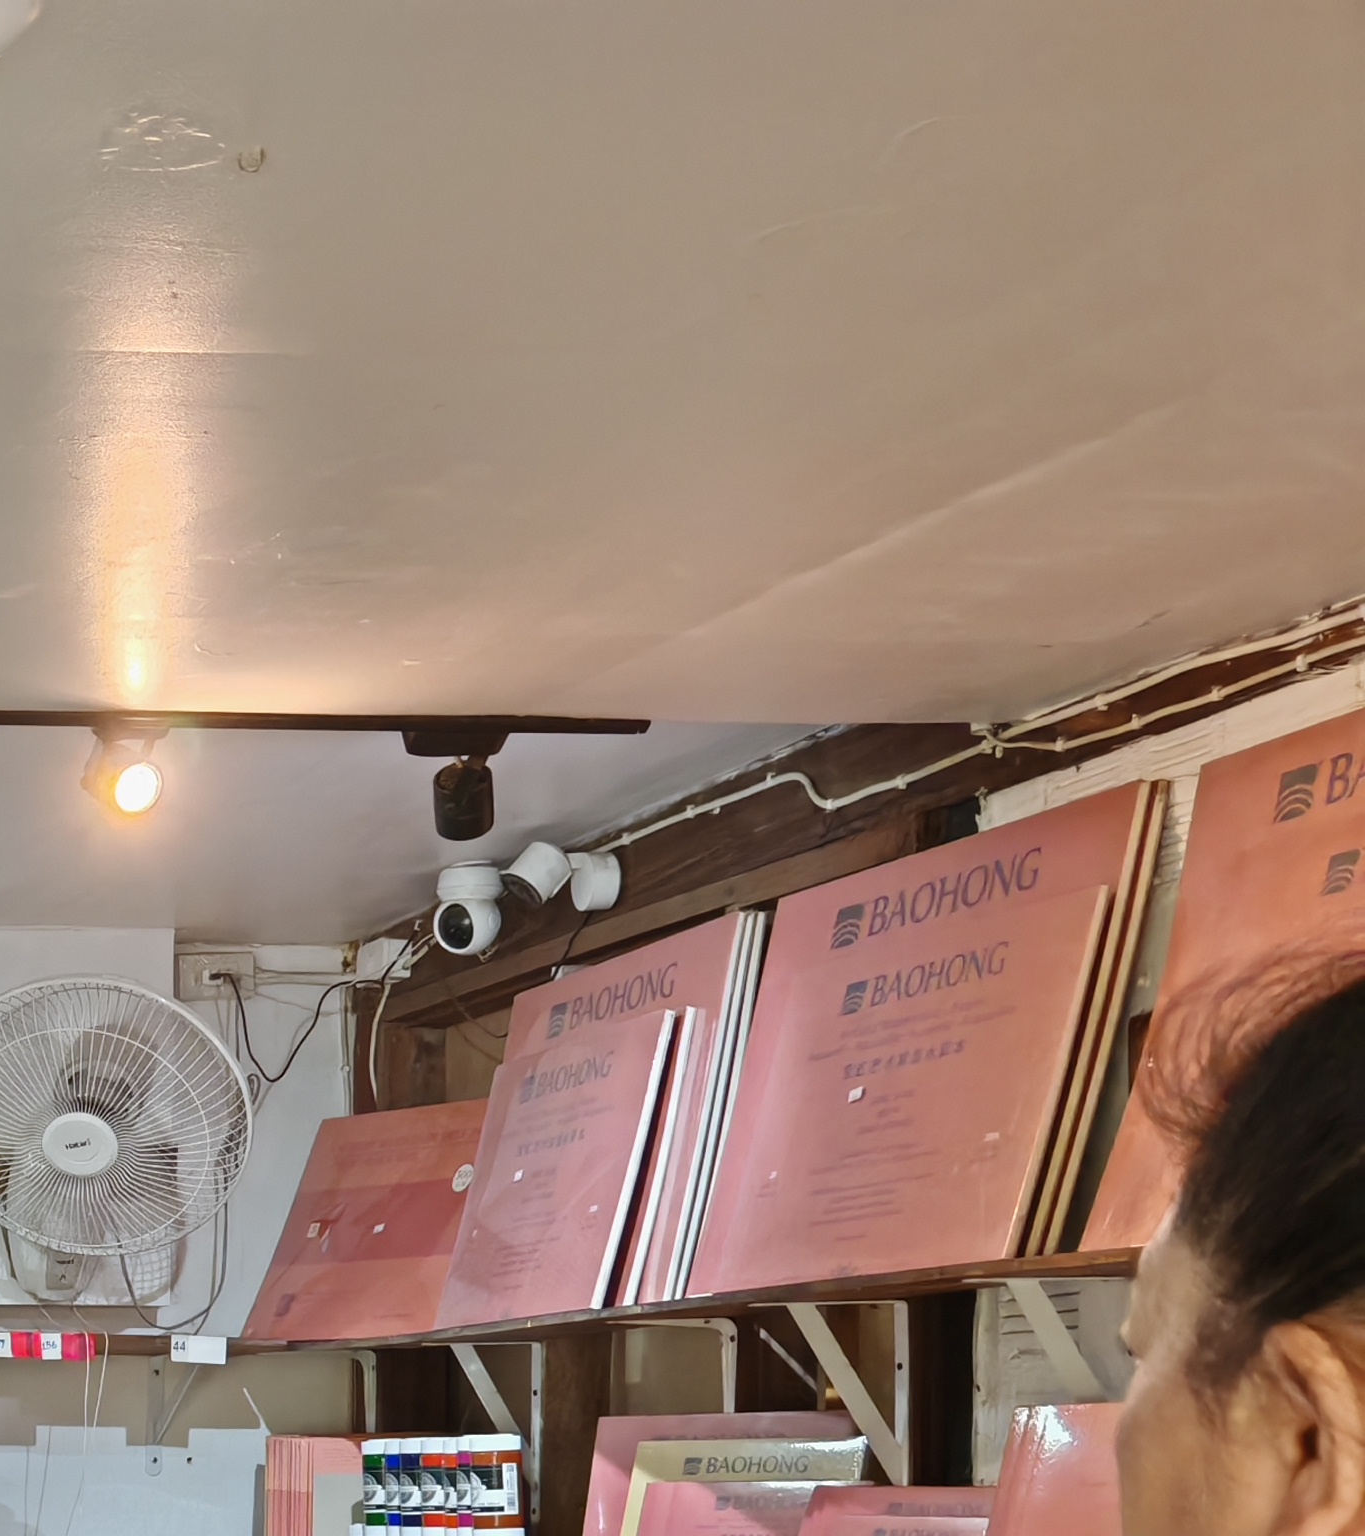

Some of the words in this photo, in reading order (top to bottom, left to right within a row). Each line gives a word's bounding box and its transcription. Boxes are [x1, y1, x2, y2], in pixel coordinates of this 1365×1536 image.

[867, 846, 1041, 938] BAOHONG
[568, 963, 677, 1030] BAOHONG
[869, 941, 1009, 1008] BAOHONG
[706, 1455, 810, 1474] BAOHONG
